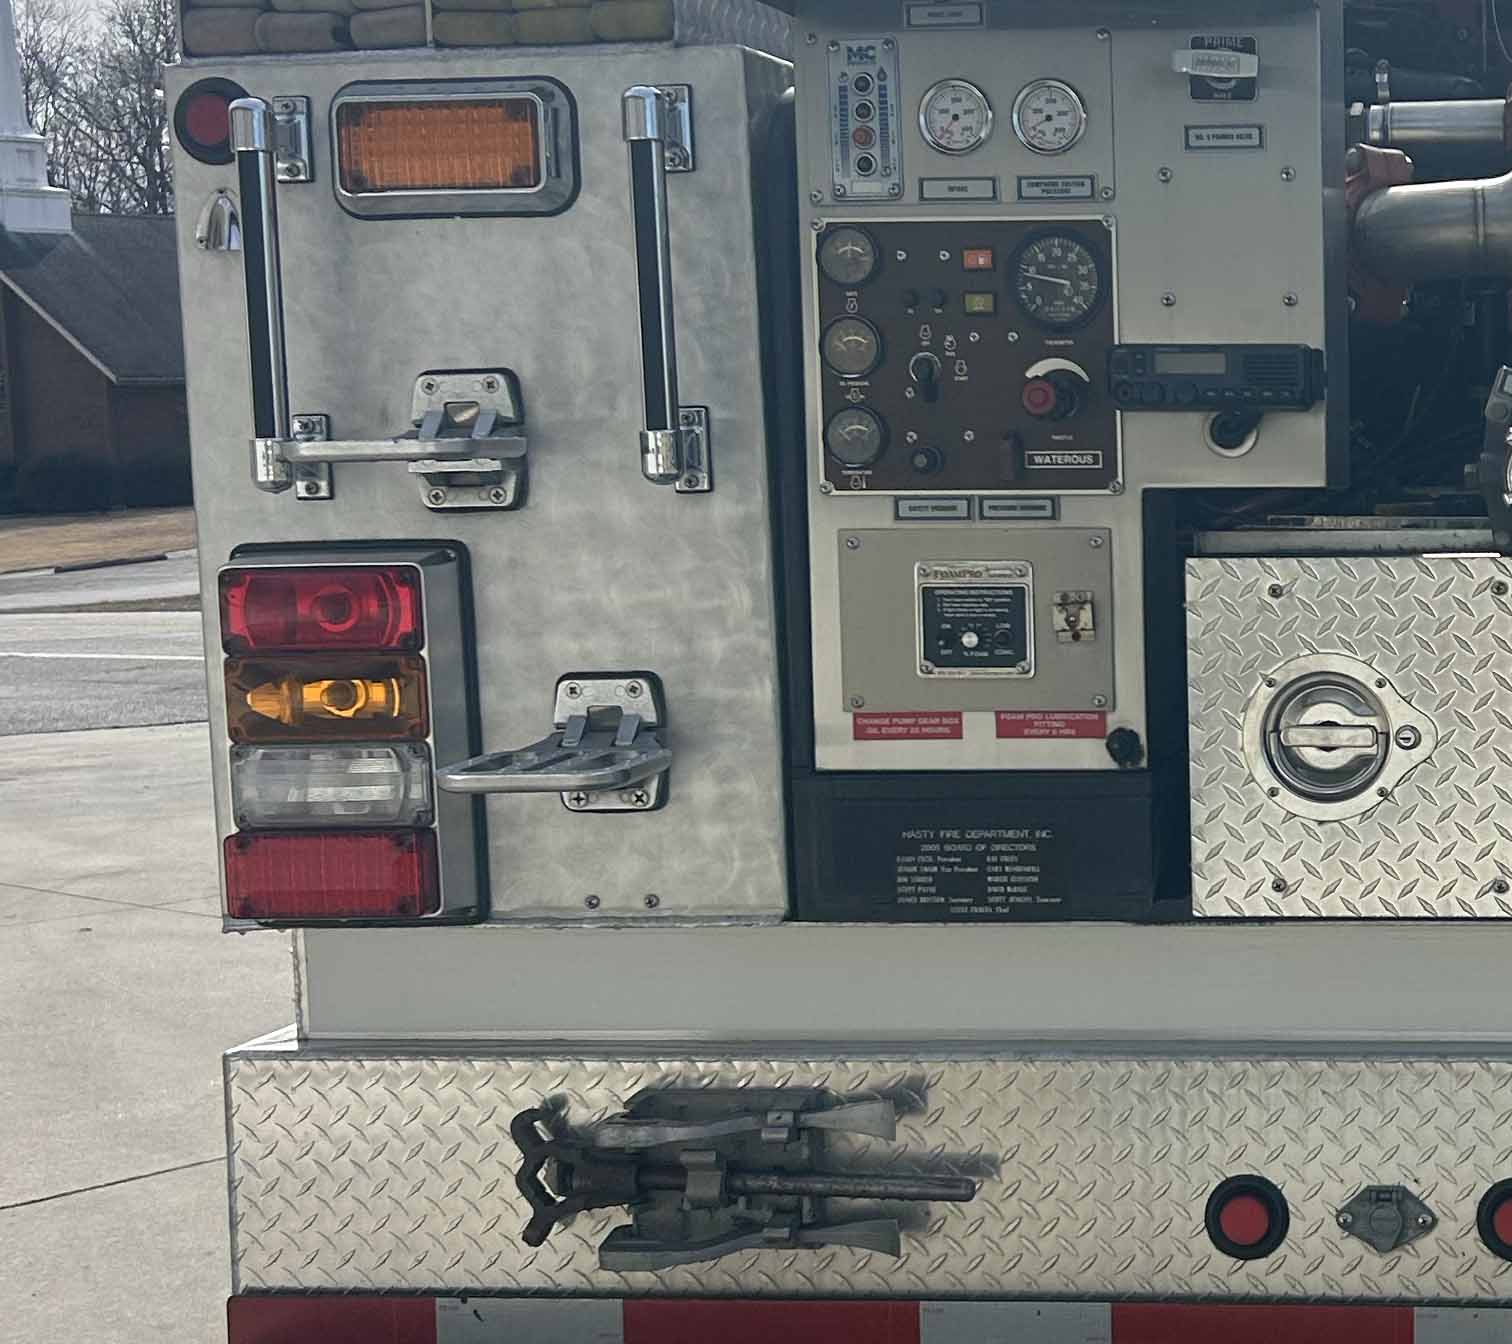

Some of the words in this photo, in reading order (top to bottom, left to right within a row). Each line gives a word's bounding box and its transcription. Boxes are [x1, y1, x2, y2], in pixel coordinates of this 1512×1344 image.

[1033, 454, 1094, 465] WATEROUS
[940, 829, 961, 839] FIRE
[944, 843, 972, 852] BOARD
[976, 843, 986, 852] OF
[990, 843, 1037, 852] DIRECTORS
